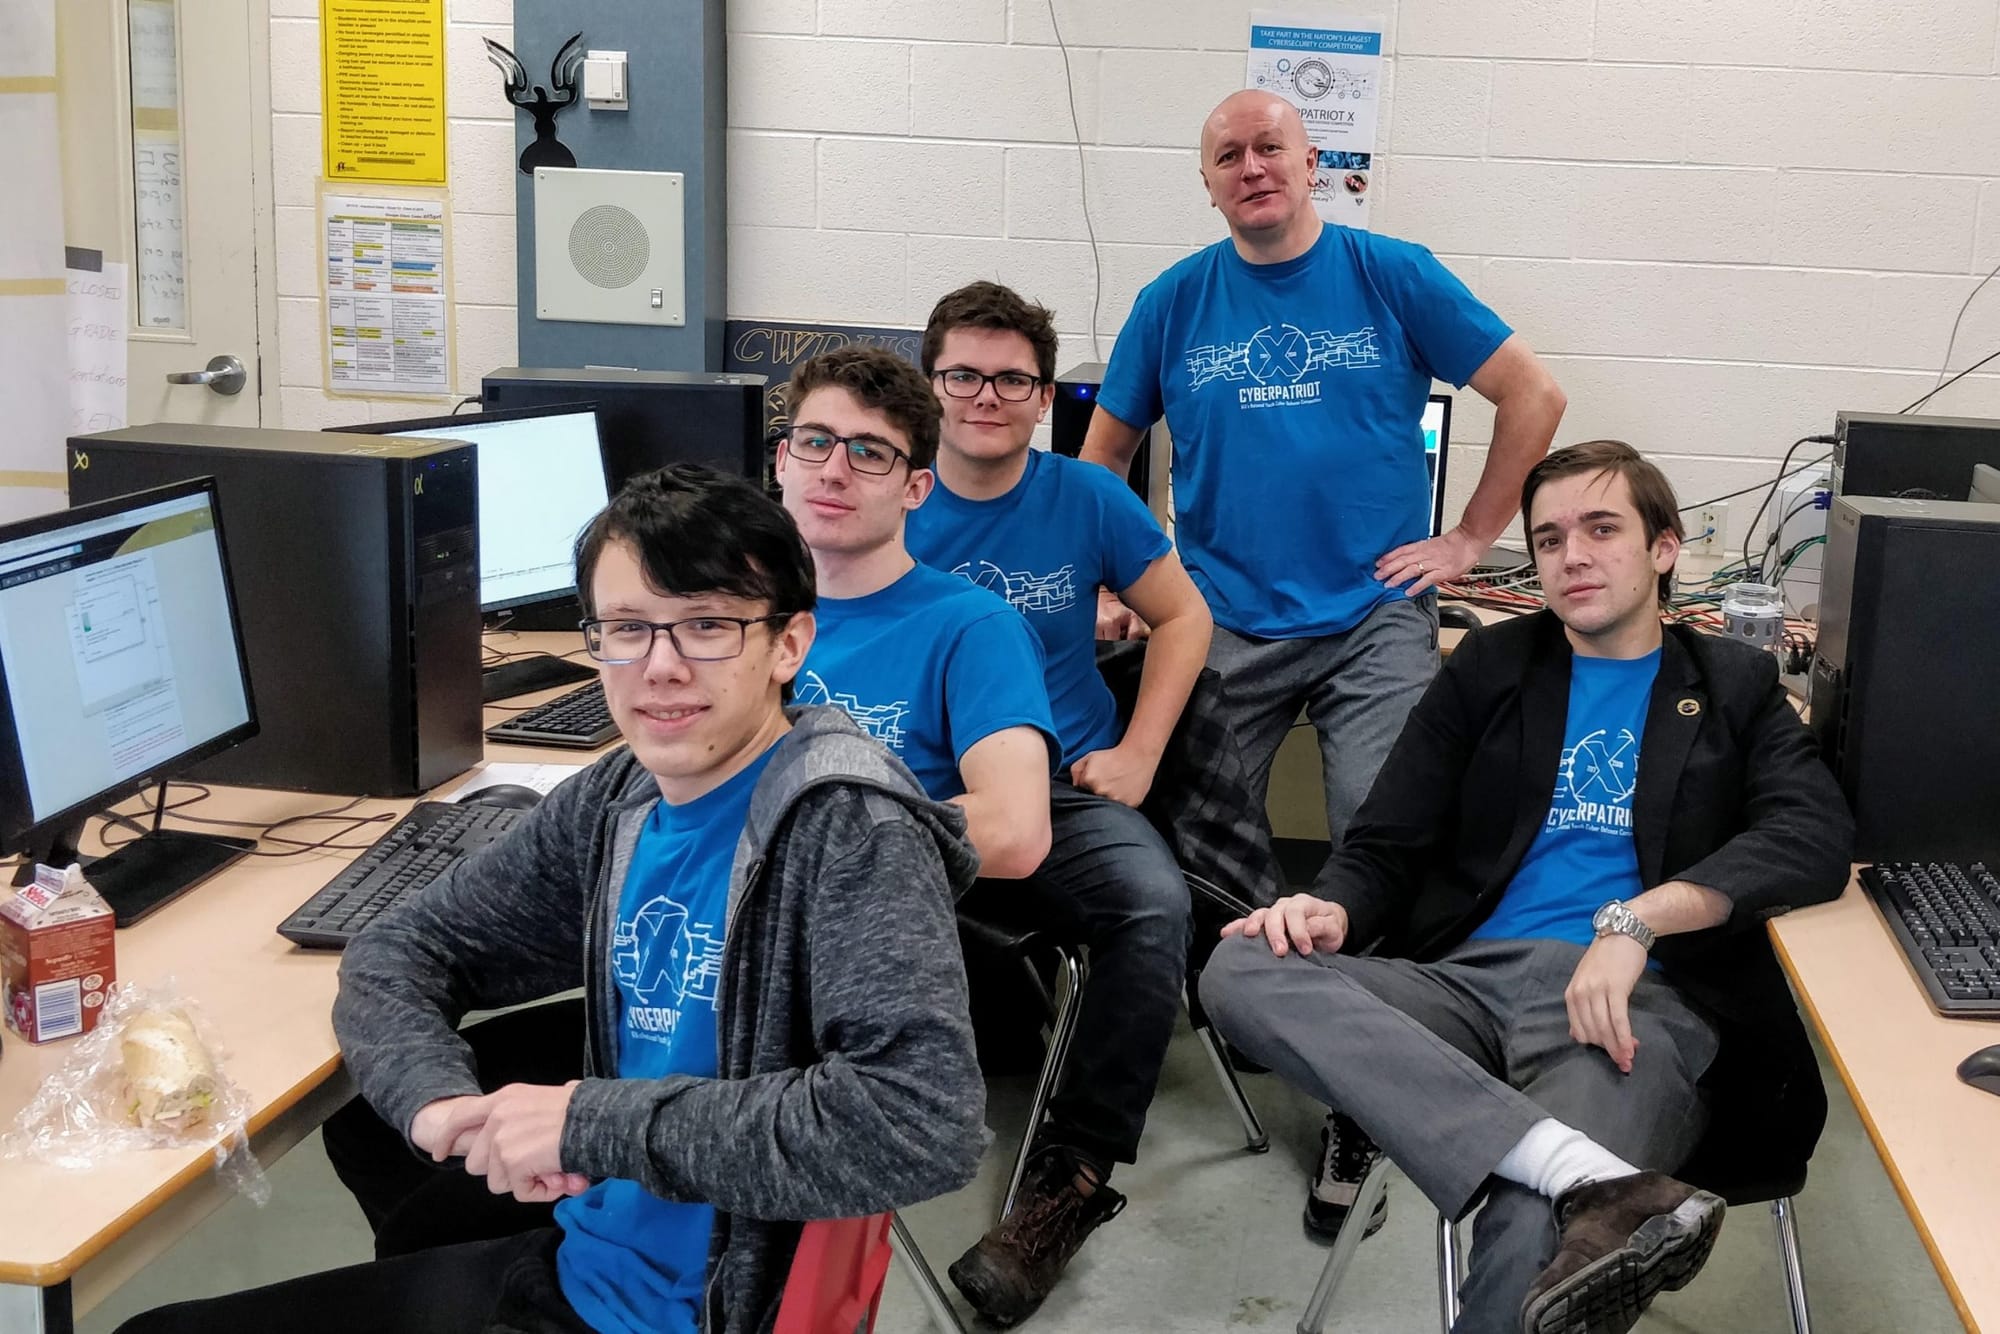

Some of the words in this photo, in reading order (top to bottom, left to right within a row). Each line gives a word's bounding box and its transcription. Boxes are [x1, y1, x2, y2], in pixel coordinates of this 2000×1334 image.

[1268, 39, 1317, 48] CYBERSECURITY
[1314, 33, 1342, 41] NATION'S
[68, 281, 121, 300] CLOSED
[1239, 381, 1321, 403] CYBERPATRIOT
